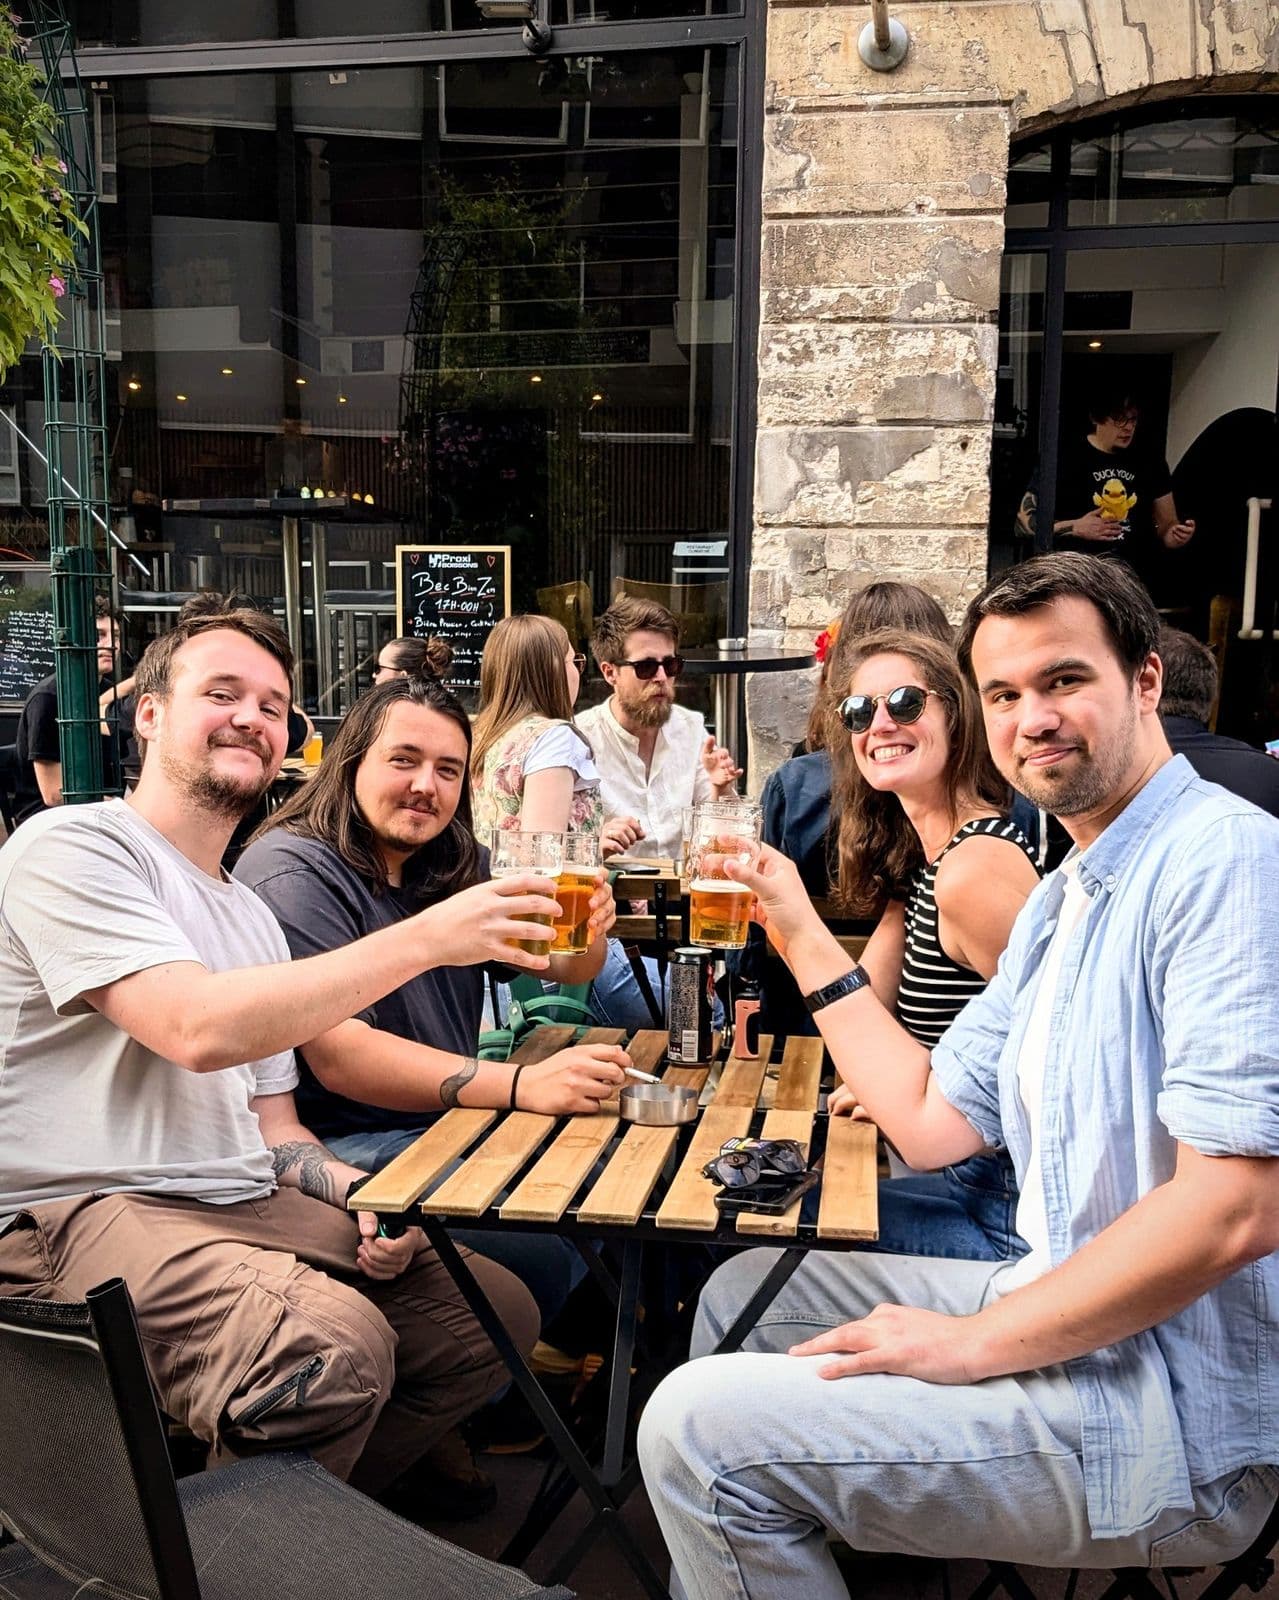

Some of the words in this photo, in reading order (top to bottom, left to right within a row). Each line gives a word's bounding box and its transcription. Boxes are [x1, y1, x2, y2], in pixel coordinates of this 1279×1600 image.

[1092, 469, 1116, 482] DUCK
[441, 554, 471, 563] Proxi
[411, 571, 450, 597] Bec
[476, 576, 496, 598] Zen
